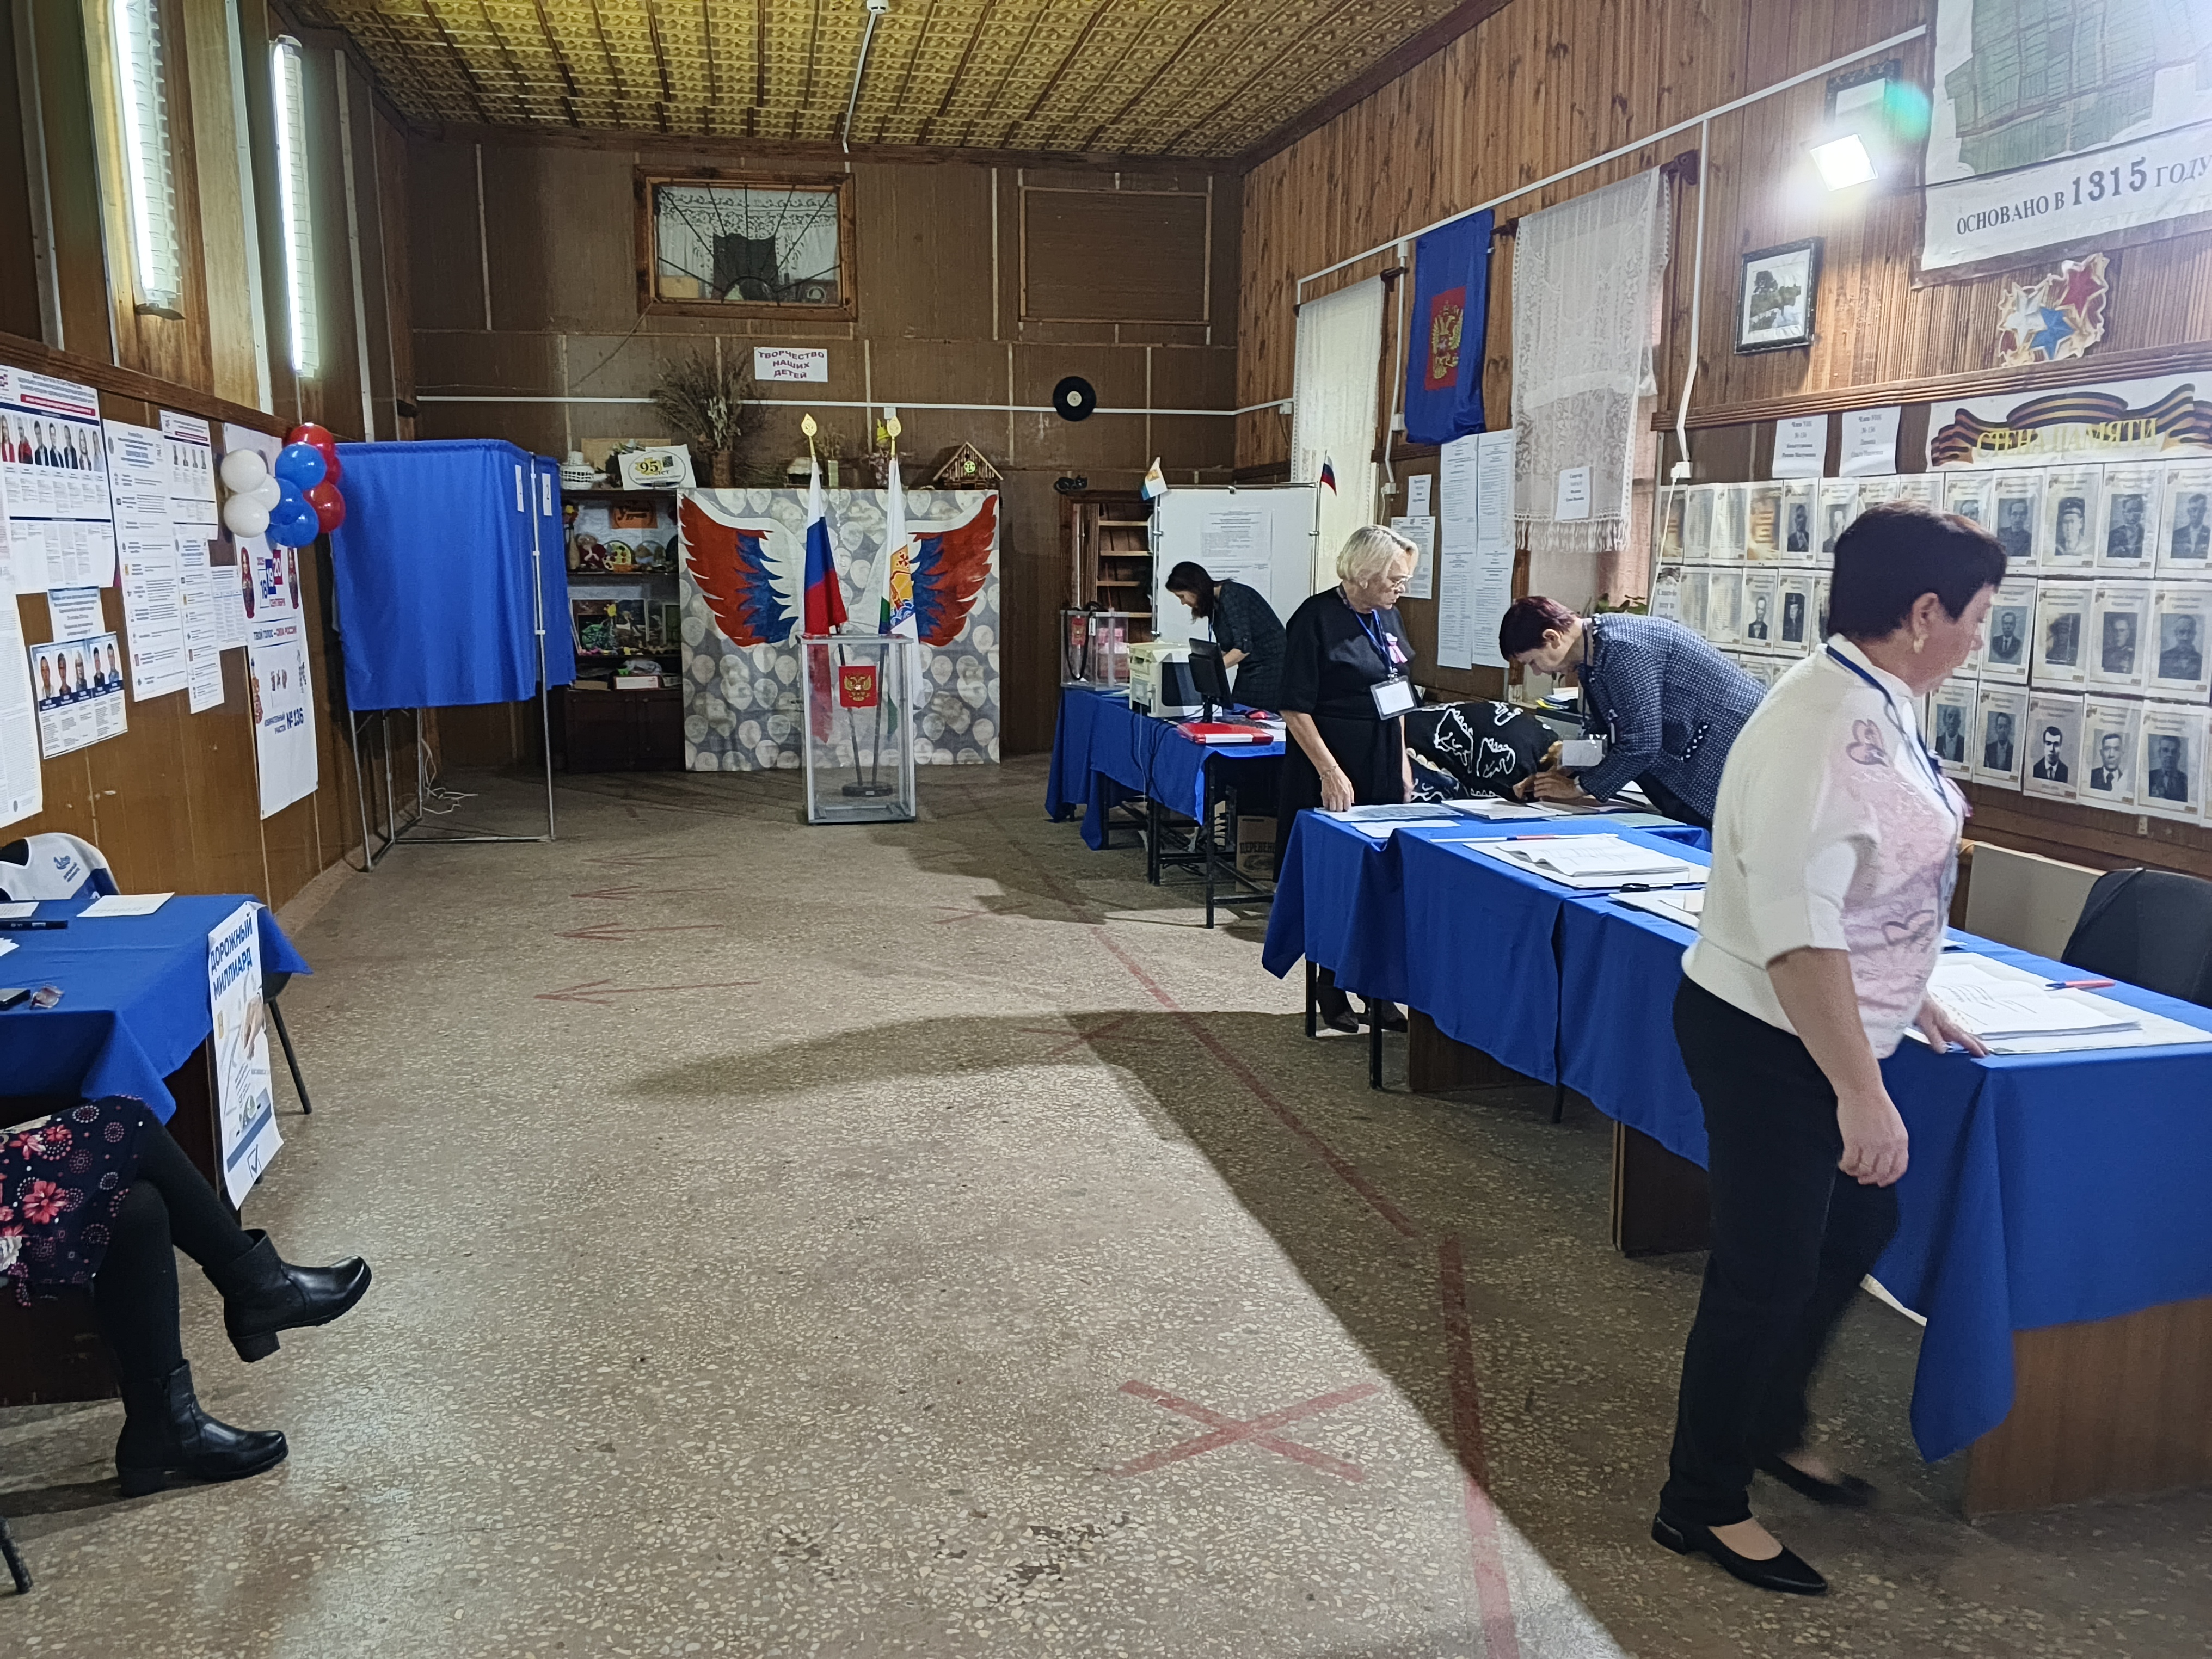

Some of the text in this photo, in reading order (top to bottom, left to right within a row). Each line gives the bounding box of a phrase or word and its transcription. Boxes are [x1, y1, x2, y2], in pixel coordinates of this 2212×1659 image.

[1957, 153, 2212, 235] ОСНОВАНО В 1315 ГОДУ
[758, 350, 825, 360] ТВОРЧЕСТВО
[772, 359, 810, 370] НАШИХ
[773, 369, 807, 379] ДЕТЕЙ
[1977, 417, 2158, 458] СТЕНА ПАМЯТИ
[640, 460, 659, 473] 95
[260, 558, 281, 599] 18 19 20
[293, 707, 304, 726] 136
[211, 912, 253, 976] ДОРОЖНЫЙ
[213, 946, 253, 1001] МИЛЛИАРД
